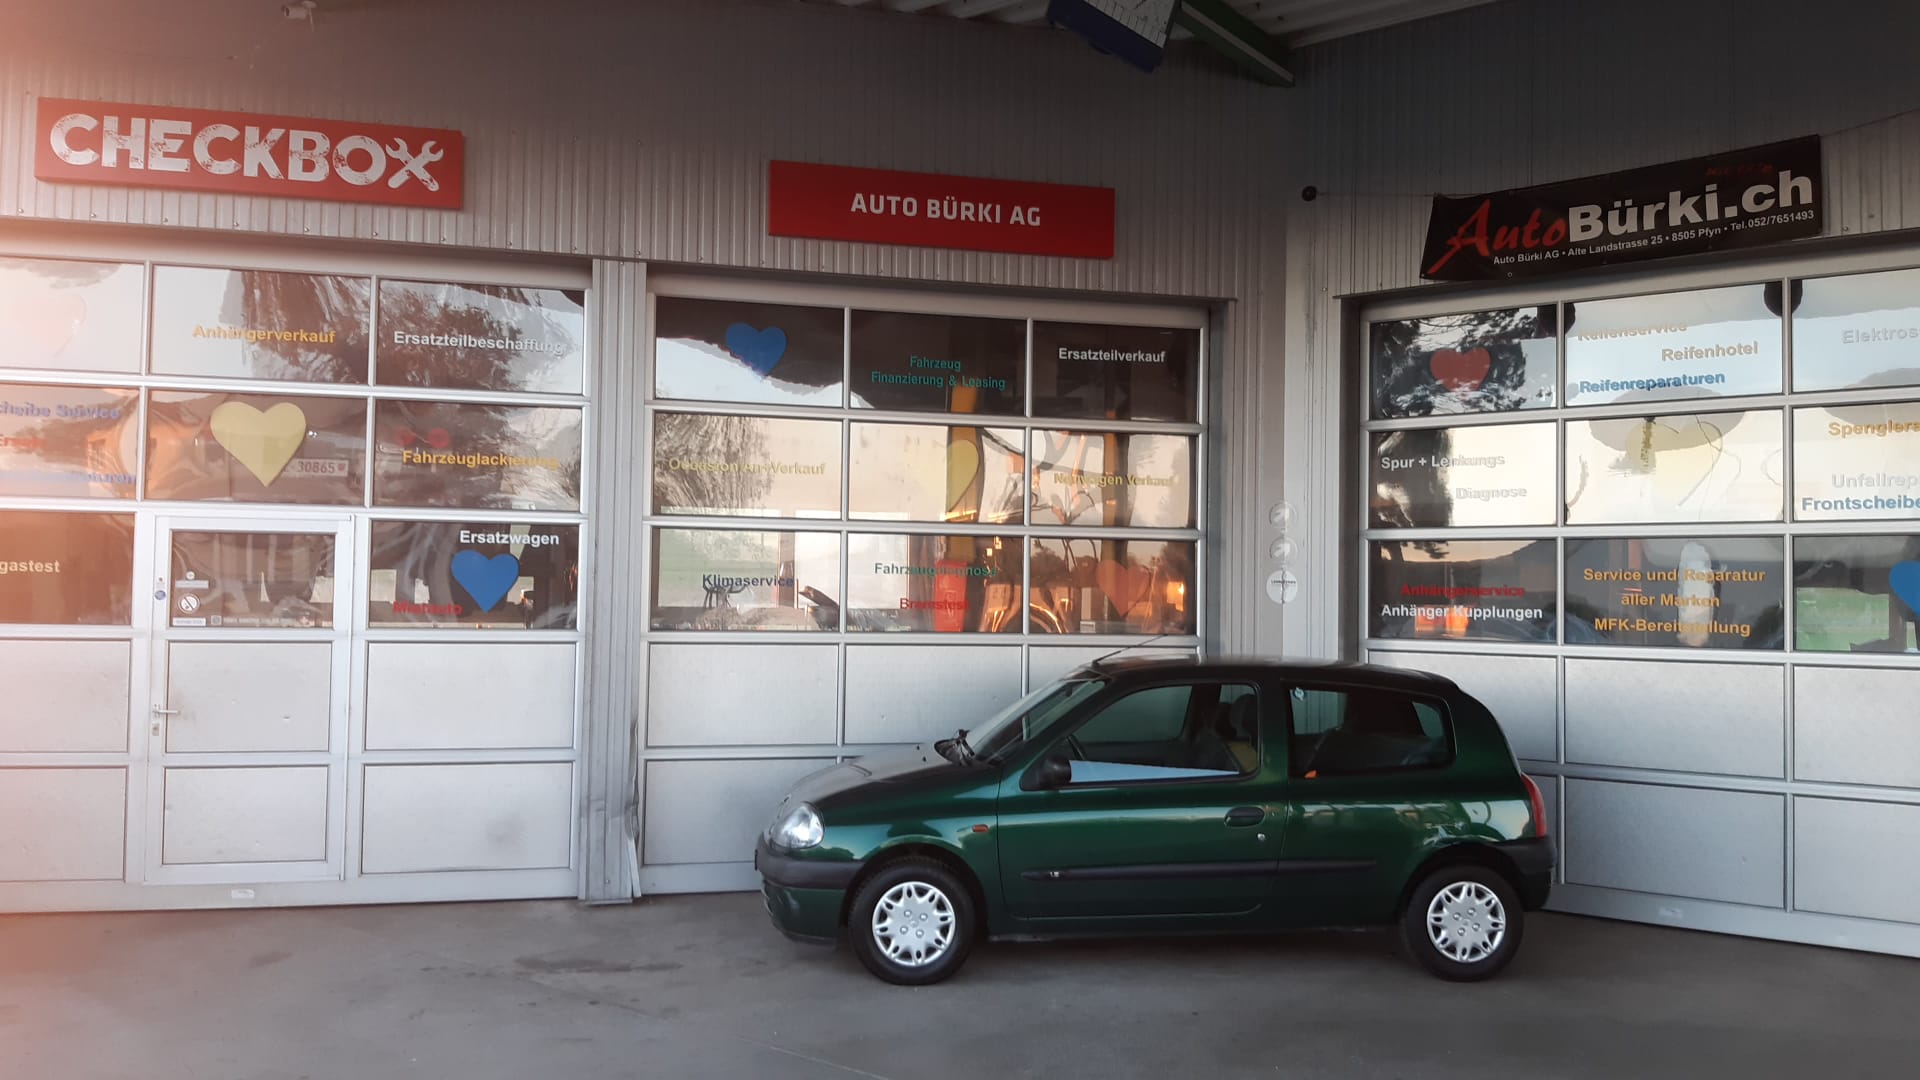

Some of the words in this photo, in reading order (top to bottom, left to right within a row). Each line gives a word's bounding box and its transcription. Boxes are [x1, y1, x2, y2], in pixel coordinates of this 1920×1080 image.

[851, 193, 918, 217] AUTO
[927, 196, 1001, 224] BÜRKI
[1009, 205, 1041, 226] AG
[1493, 256, 1515, 264] Auto
[1517, 251, 1543, 262] Bürki
[1544, 249, 1560, 259] AG
[1567, 248, 1587, 257] Alte
[1589, 238, 1649, 254] Landstrasse
[1650, 236, 1663, 245] 25
[1671, 230, 1696, 242] 8505
[1698, 227, 1721, 240] Pfyn
[192, 324, 336, 343] Anhängerverkauf
[393, 330, 564, 355] Ersatzteilbeschaffung
[1661, 340, 1758, 361] Reifenhotel
[910, 355, 961, 371] Fahrzeug
[1058, 347, 1166, 363] Ersatzteilverkauf
[871, 371, 944, 387] Finanzierung
[948, 375, 957, 386] &
[961, 376, 1006, 390] Leasing
[1579, 373, 1726, 393] Reifenreparaturen
[402, 450, 558, 470] Fahrzeuglackierung
[1381, 456, 1415, 471] Spur
[1418, 458, 1427, 467] +
[1431, 454, 1506, 468] Lenkungs
[1455, 487, 1528, 502] Diagnose
[459, 530, 560, 548] Ersatzwagen
[702, 574, 795, 588] Klimaservice
[1583, 568, 1642, 581] Service
[1646, 568, 1677, 581] und
[1683, 568, 1766, 584] Reparatur
[1401, 583, 1526, 599] Anhängerservice
[1621, 592, 1656, 606] aller
[1660, 593, 1720, 607] Marken
[392, 600, 463, 615] Mietauto
[1381, 604, 1449, 620] Anhänger
[1453, 604, 1543, 619] Kupplungen
